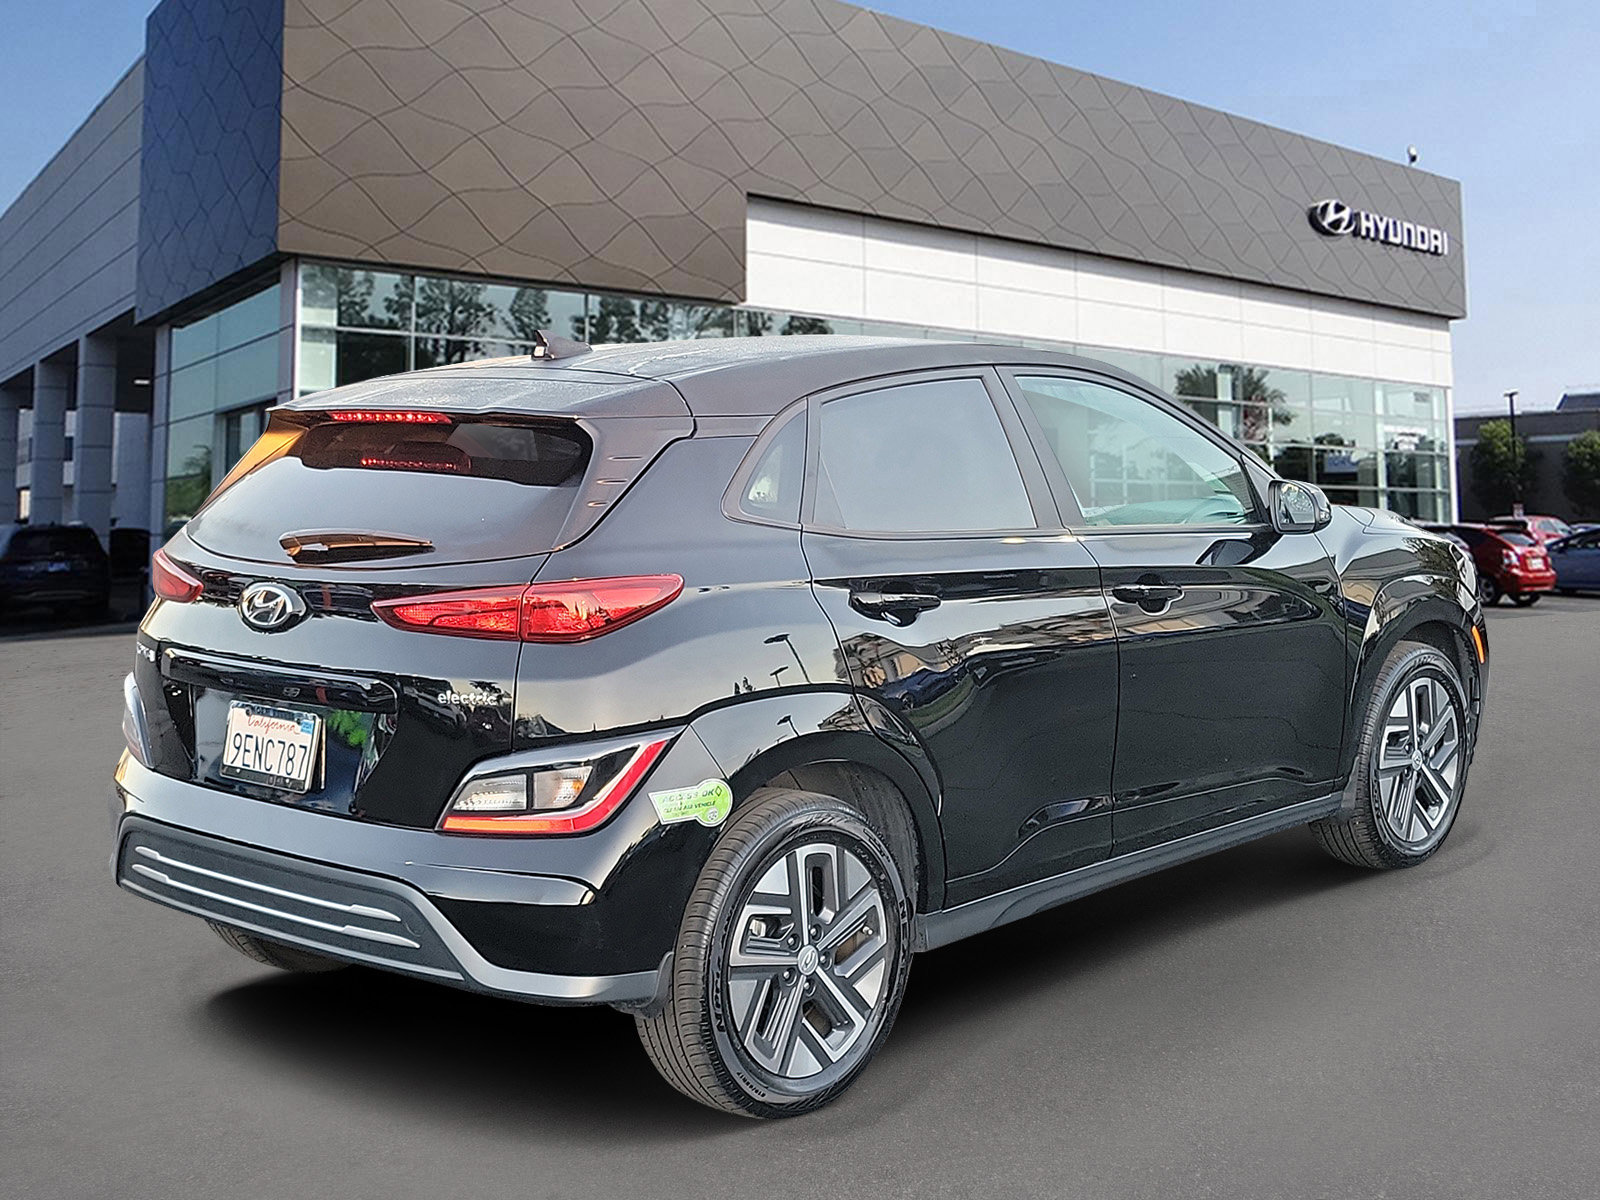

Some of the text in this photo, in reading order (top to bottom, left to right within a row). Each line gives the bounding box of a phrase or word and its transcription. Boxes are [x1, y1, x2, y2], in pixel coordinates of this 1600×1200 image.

[1360, 211, 1448, 255] HYUNDAI
[437, 690, 498, 706] electric
[230, 732, 308, 779] 9ENC787
